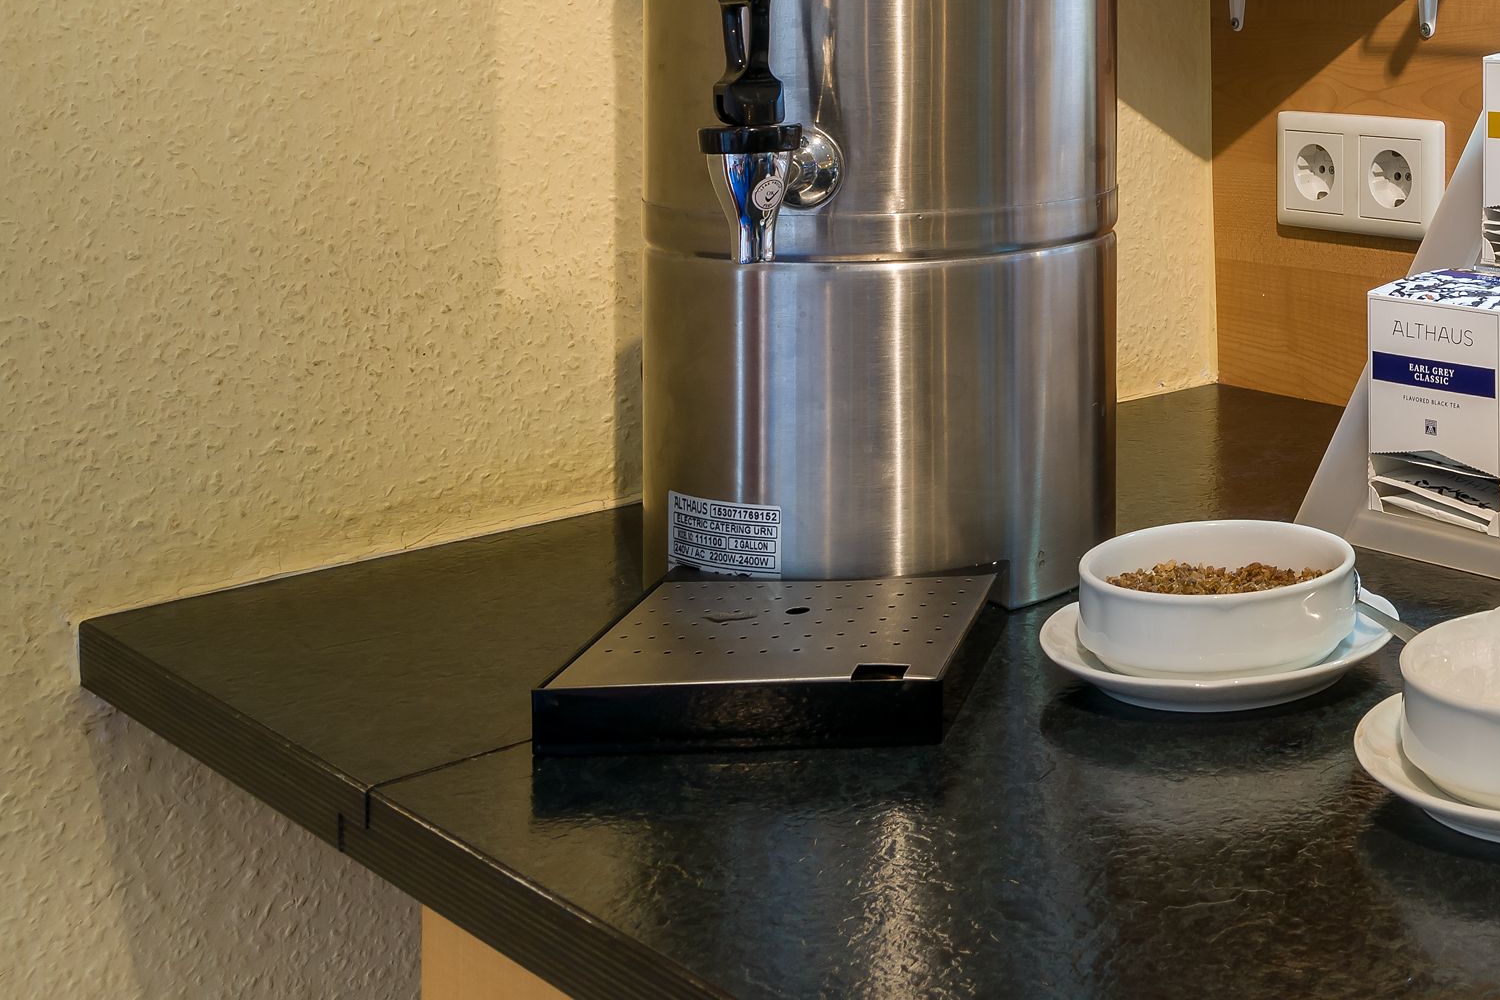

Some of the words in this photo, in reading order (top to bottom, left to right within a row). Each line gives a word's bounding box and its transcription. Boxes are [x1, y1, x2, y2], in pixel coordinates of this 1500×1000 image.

[1392, 320, 1474, 347] ALTHAUS
[1408, 362, 1430, 374] EARL
[1432, 366, 1455, 378] GREY
[1414, 372, 1449, 385] CLASSIC
[1403, 394, 1430, 404] FLAVORED
[1431, 398, 1448, 407] BLACK
[1449, 401, 1460, 409] TEA
[674, 495, 708, 515] ALTHAUS
[676, 514, 708, 529] ELECTRIC
[710, 521, 751, 535] CATERING
[753, 526, 773, 536] URN
[739, 540, 769, 551] GALLON
[674, 543, 689, 556] 240V
[694, 548, 705, 559] AC
[709, 551, 769, 567] 2200W-2400W
